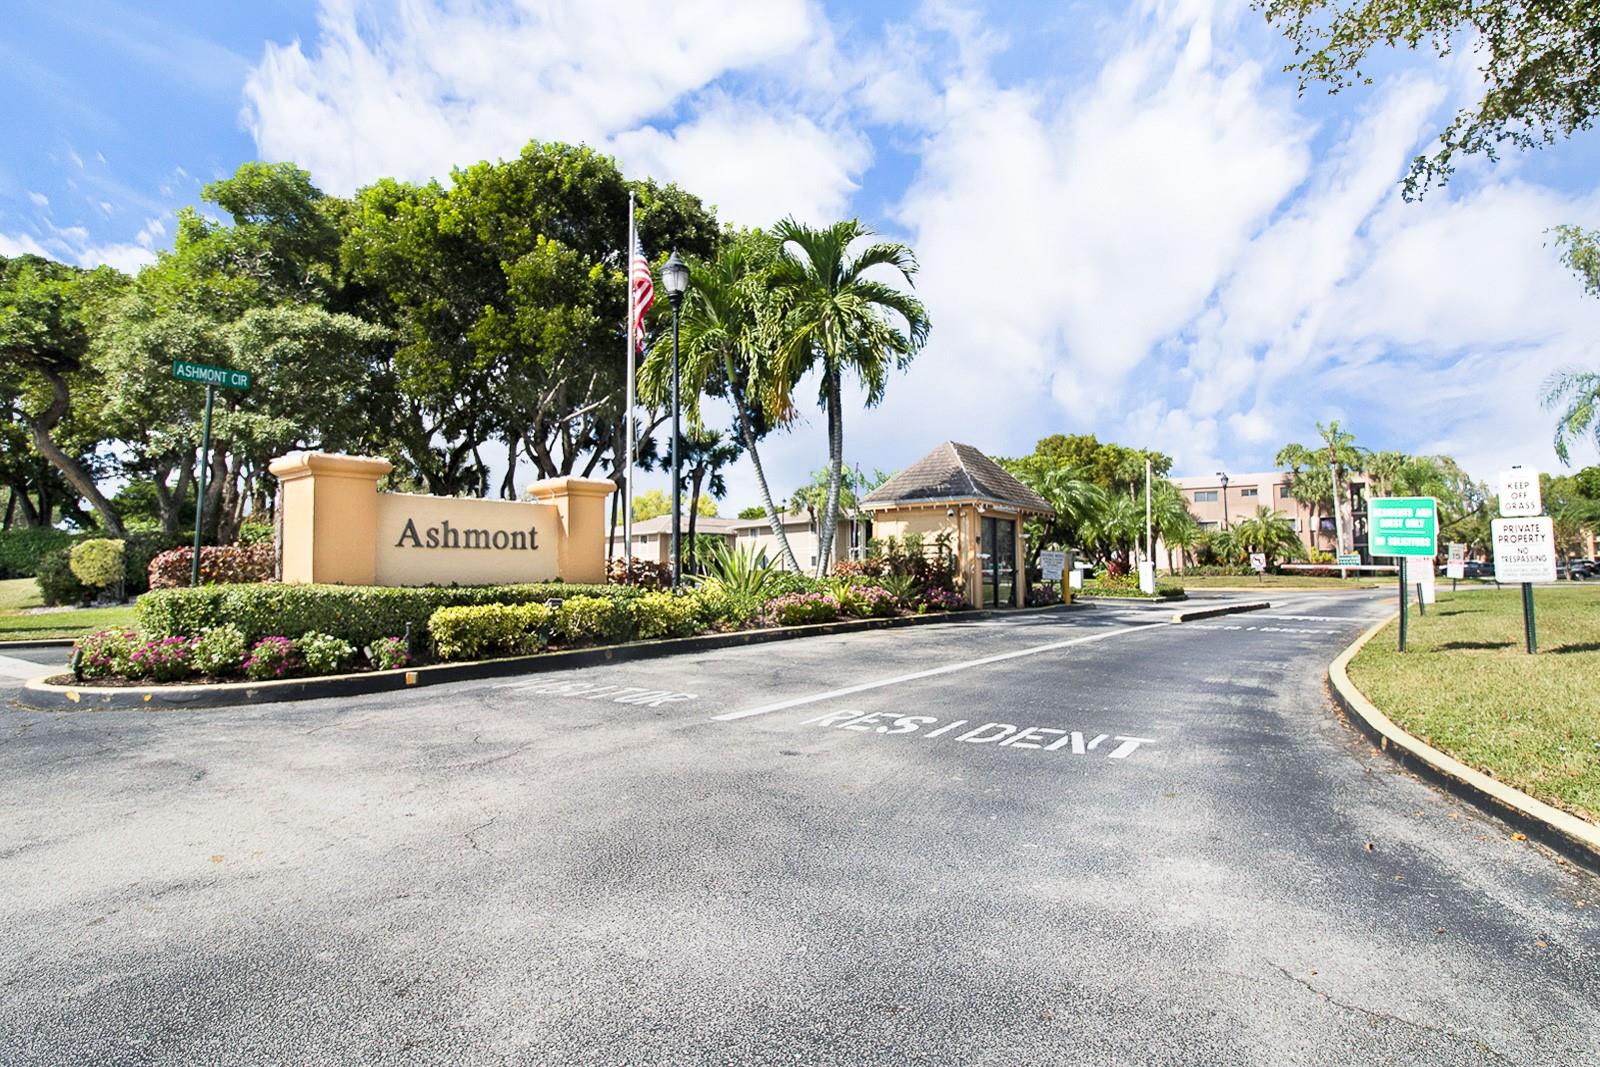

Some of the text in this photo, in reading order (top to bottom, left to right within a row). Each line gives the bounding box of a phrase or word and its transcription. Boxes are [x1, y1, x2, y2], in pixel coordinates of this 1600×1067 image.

[176, 364, 248, 387] ASHMONT CIR
[1507, 481, 1530, 490] KEEP
[1511, 492, 1527, 500] OFF
[1504, 502, 1535, 510] GRASS
[1503, 523, 1540, 533] PRIVATE
[394, 518, 539, 550] Ashmont
[1498, 533, 1546, 544] PROPERTY
[1517, 546, 1529, 555] NO
[1501, 554, 1547, 563] TRESPASSING
[799, 708, 1157, 759] RESIDENT
